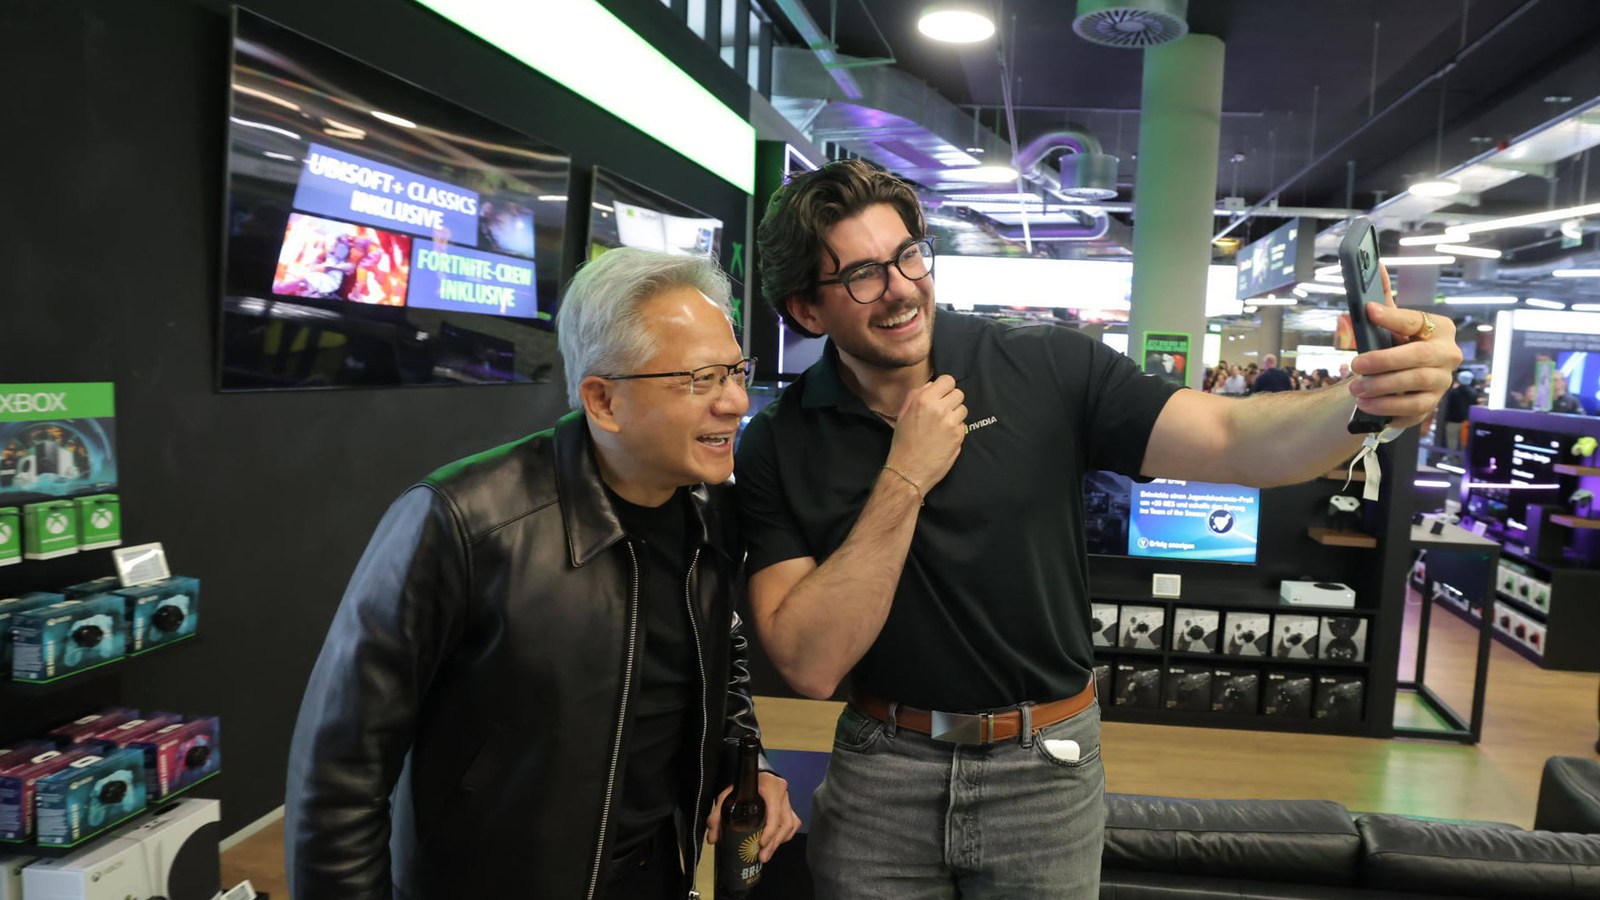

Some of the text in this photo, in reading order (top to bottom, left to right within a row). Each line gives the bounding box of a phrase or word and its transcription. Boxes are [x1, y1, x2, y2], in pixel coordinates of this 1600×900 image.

[309, 152, 478, 216] UBISOFT+ CLASSICS
[350, 190, 445, 230] INKLUSIVE
[417, 249, 533, 285] FORTNITE-CREW
[440, 279, 516, 308] INKLUSIVE
[0, 392, 68, 413] XBOX
